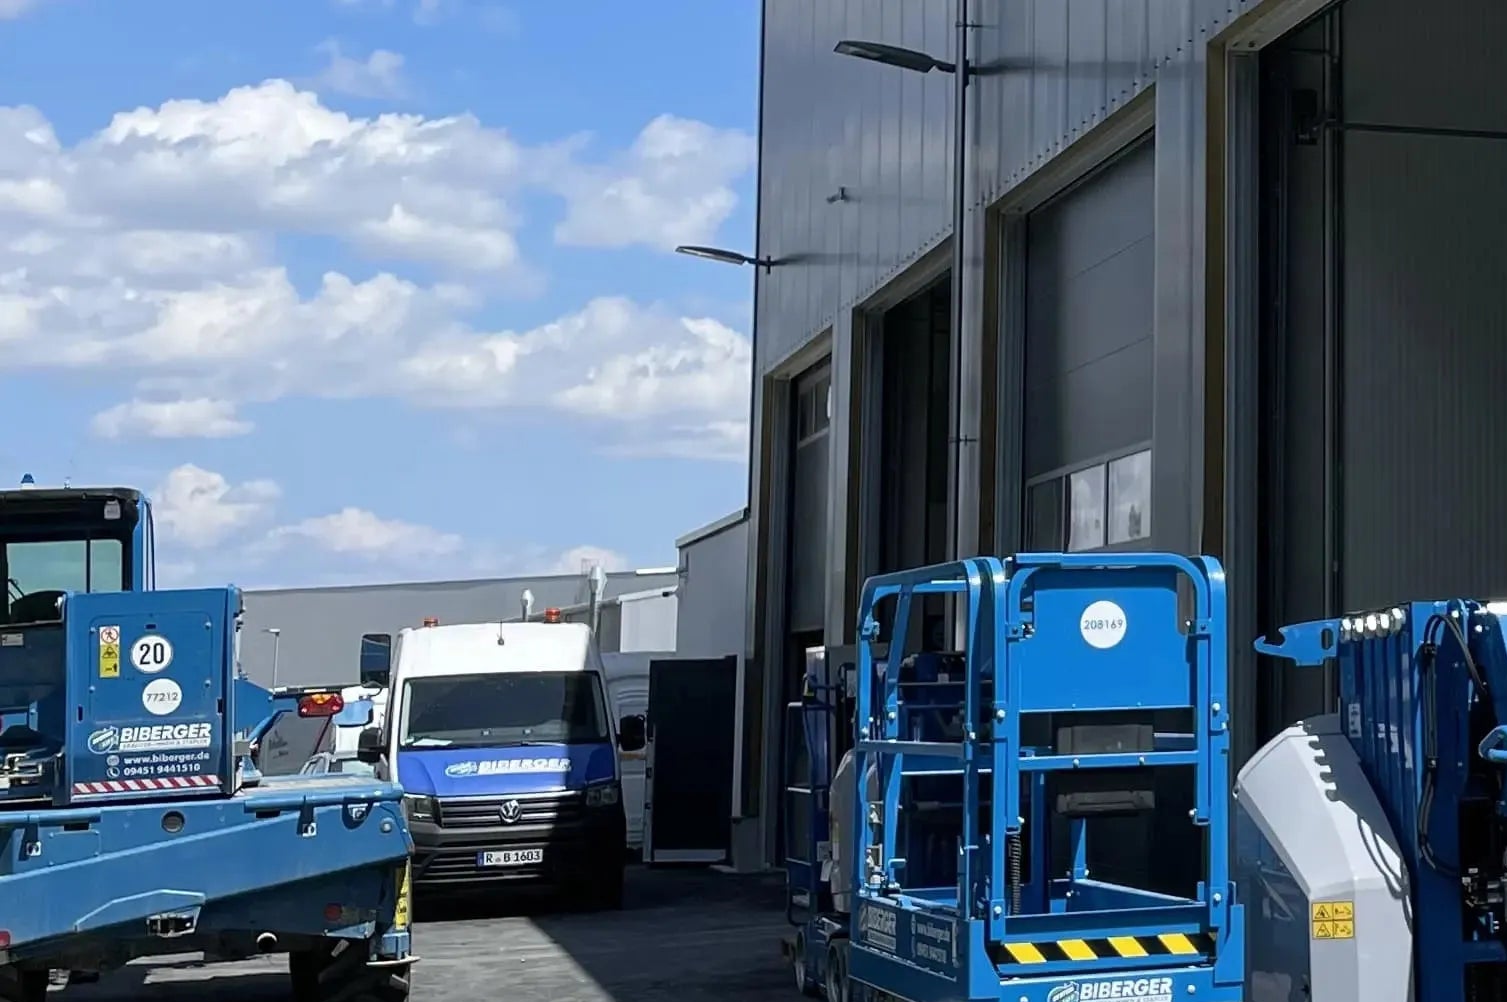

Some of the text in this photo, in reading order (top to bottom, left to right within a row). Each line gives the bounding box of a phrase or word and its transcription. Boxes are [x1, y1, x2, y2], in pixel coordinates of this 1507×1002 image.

[1083, 618, 1124, 630] 208169
[139, 642, 165, 665] 20
[146, 691, 179, 702] 77212
[120, 723, 212, 742] BIBERGER
[123, 751, 210, 765] www.biberger.de
[123, 763, 201, 776] 09451 9441510
[1080, 977, 1173, 1000] BIBERGER
